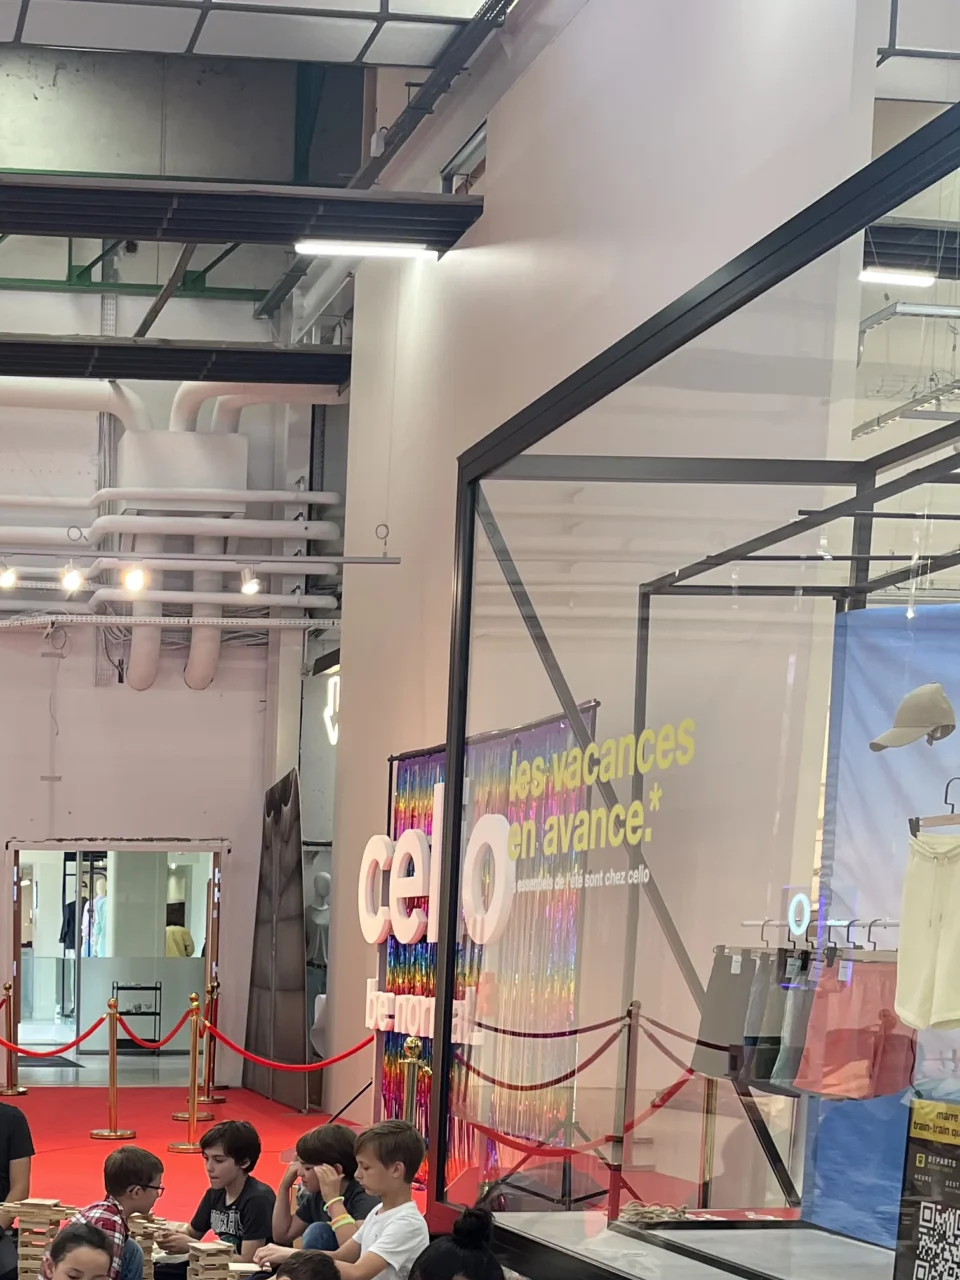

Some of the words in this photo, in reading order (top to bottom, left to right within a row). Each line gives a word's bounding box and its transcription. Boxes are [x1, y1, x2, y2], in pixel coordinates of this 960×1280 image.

[509, 750, 545, 802] les
[552, 718, 696, 792] vacances
[507, 819, 536, 861] en
[358, 783, 515, 944] celo
[584, 872, 603, 887] sont
[605, 868, 626, 886] chez
[627, 864, 650, 884] celio
[913, 1120, 950, 1136] train-train
[936, 1111, 959, 1123] marre
